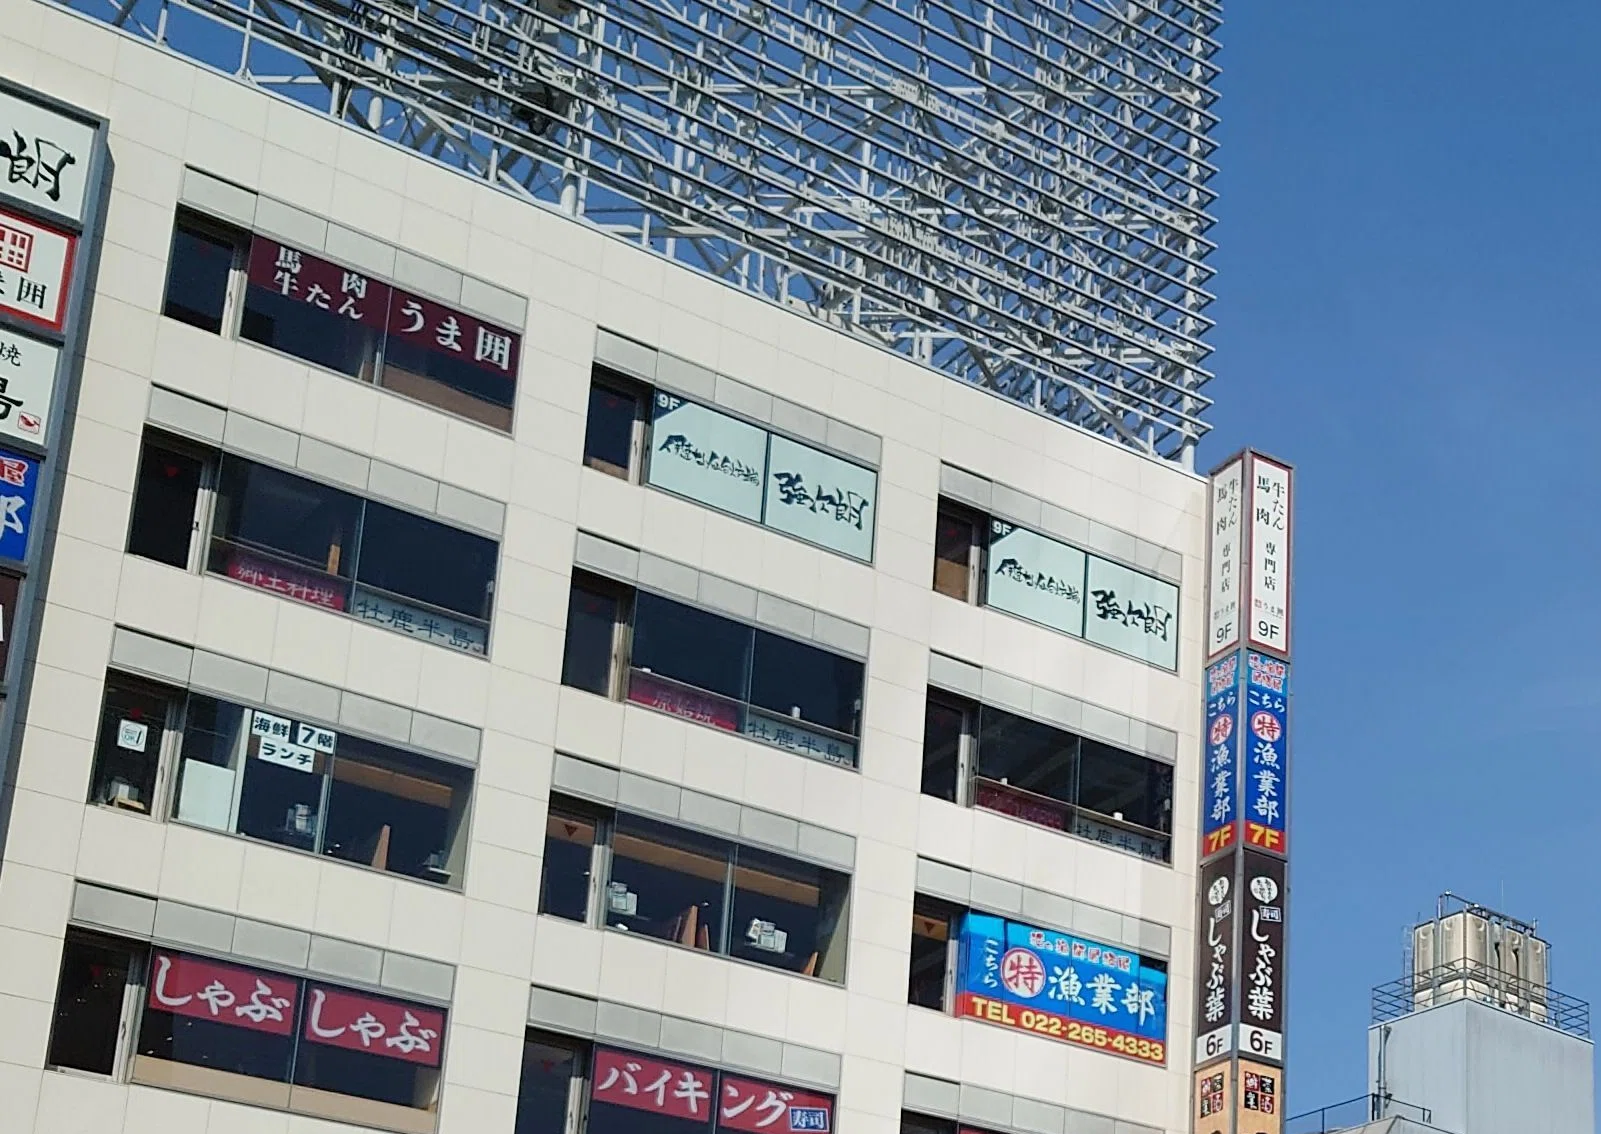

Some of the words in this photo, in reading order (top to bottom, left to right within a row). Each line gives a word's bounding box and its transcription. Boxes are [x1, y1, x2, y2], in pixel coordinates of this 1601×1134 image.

[273, 271, 364, 320] 牛たん
[400, 300, 513, 371] うま囲
[658, 394, 681, 412] 9F
[1228, 478, 1239, 528] 牛たん
[1256, 475, 1270, 525] 馬肉
[1272, 482, 1285, 531] 牛たん
[992, 522, 1012, 536] 9F
[1264, 541, 1277, 591] 専門店
[1216, 622, 1233, 643] 9F
[1258, 620, 1280, 640] 9F
[1208, 691, 1236, 716] こちら
[1248, 690, 1286, 713] こちら
[254, 715, 290, 739] 海鮮
[300, 724, 334, 752] 7階
[261, 742, 313, 767] ランチ
[1208, 824, 1232, 852] 7F
[1249, 822, 1280, 848] 7F
[983, 938, 999, 989] こちら
[1205, 917, 1227, 1022] しゃぶ葉
[1248, 908, 1276, 1021] しゃぶ葉
[971, 997, 1015, 1025] TEL
[1206, 1034, 1223, 1057] 6F
[1249, 1029, 1273, 1055] 6F
[598, 1062, 794, 1128] バイキング
[792, 1109, 826, 1131] 寿司
